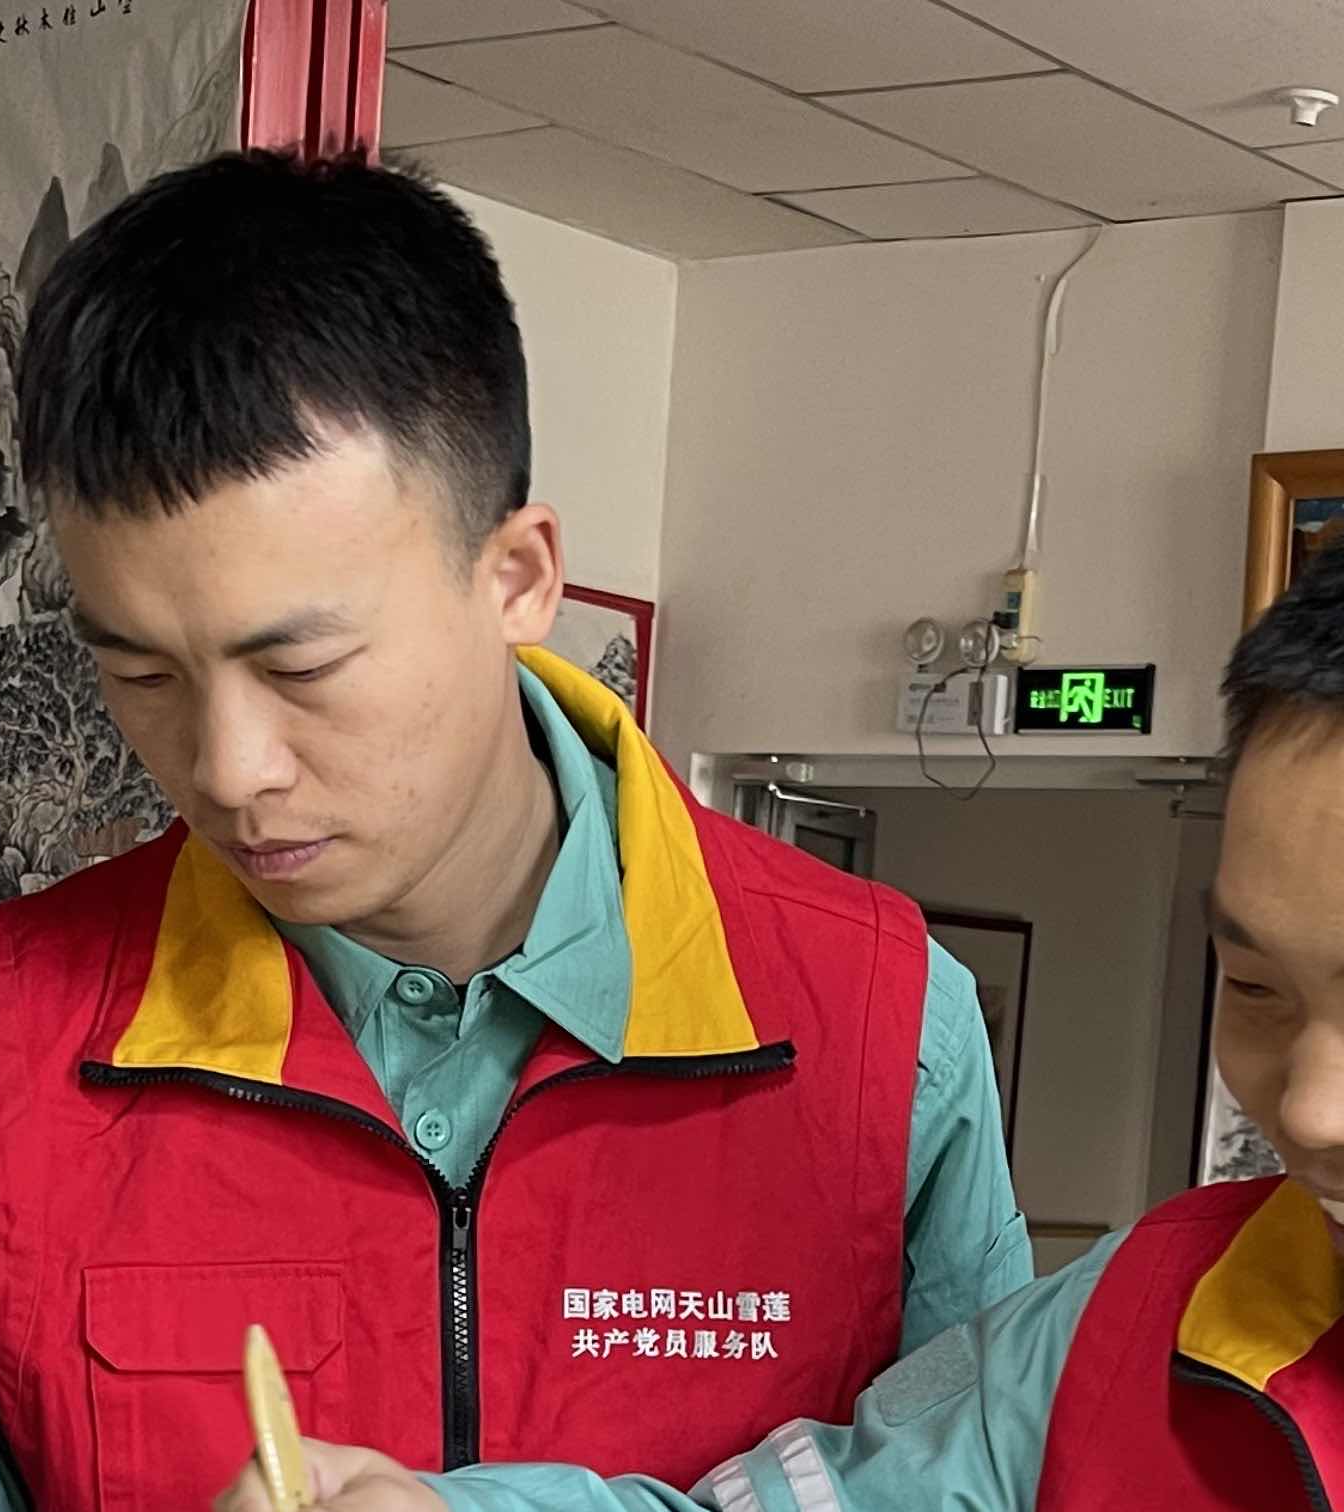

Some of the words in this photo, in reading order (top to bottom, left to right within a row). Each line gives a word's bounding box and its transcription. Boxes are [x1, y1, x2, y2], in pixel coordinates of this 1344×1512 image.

[1103, 687, 1135, 709] EXIT
[562, 1288, 791, 1322] 国家电网天山雪莲
[571, 1327, 778, 1360] 共产党员服务队
